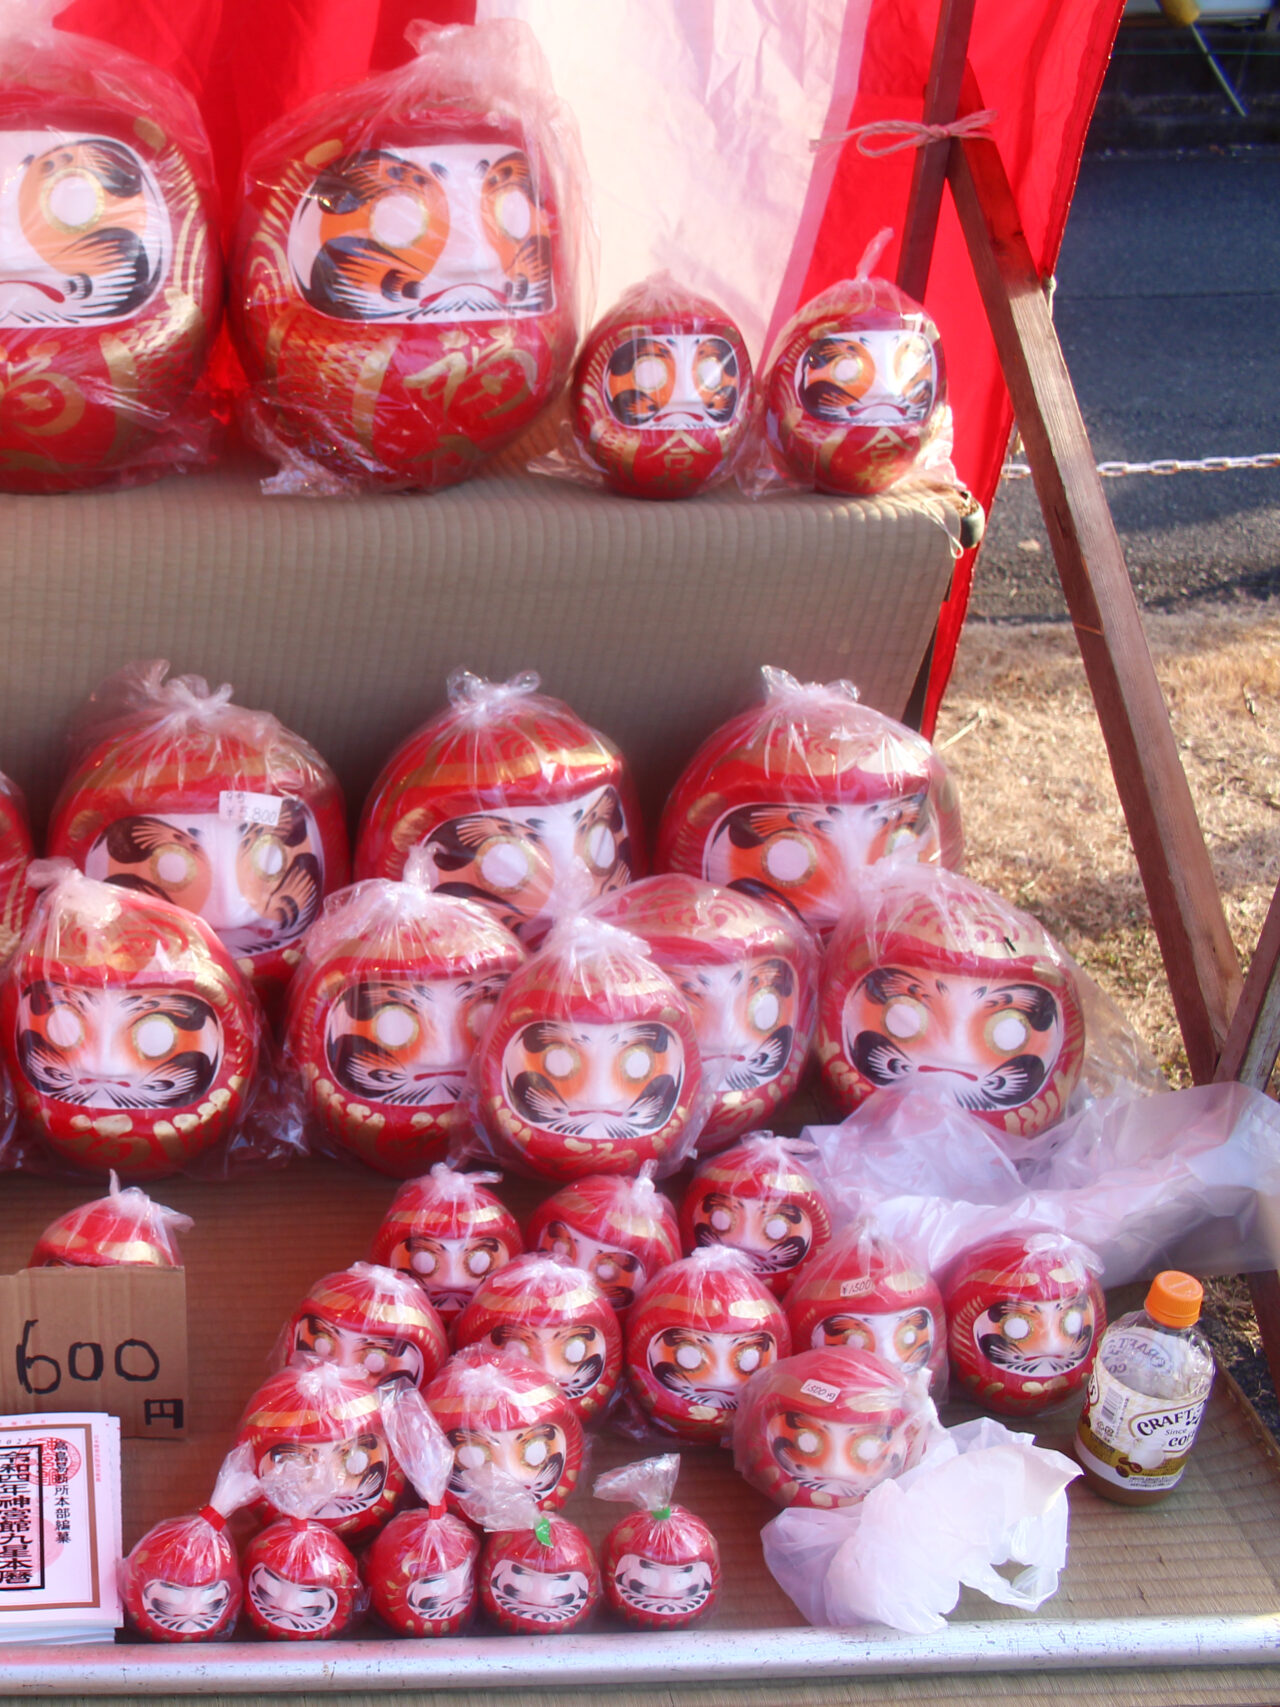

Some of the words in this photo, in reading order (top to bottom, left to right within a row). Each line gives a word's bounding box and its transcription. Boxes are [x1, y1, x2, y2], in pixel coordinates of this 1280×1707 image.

[16, 1319, 161, 1394] 600
[144, 1398, 184, 1429] 円
[1136, 1408, 1194, 1437] CRAFT
[1165, 1427, 1187, 1436] Since
